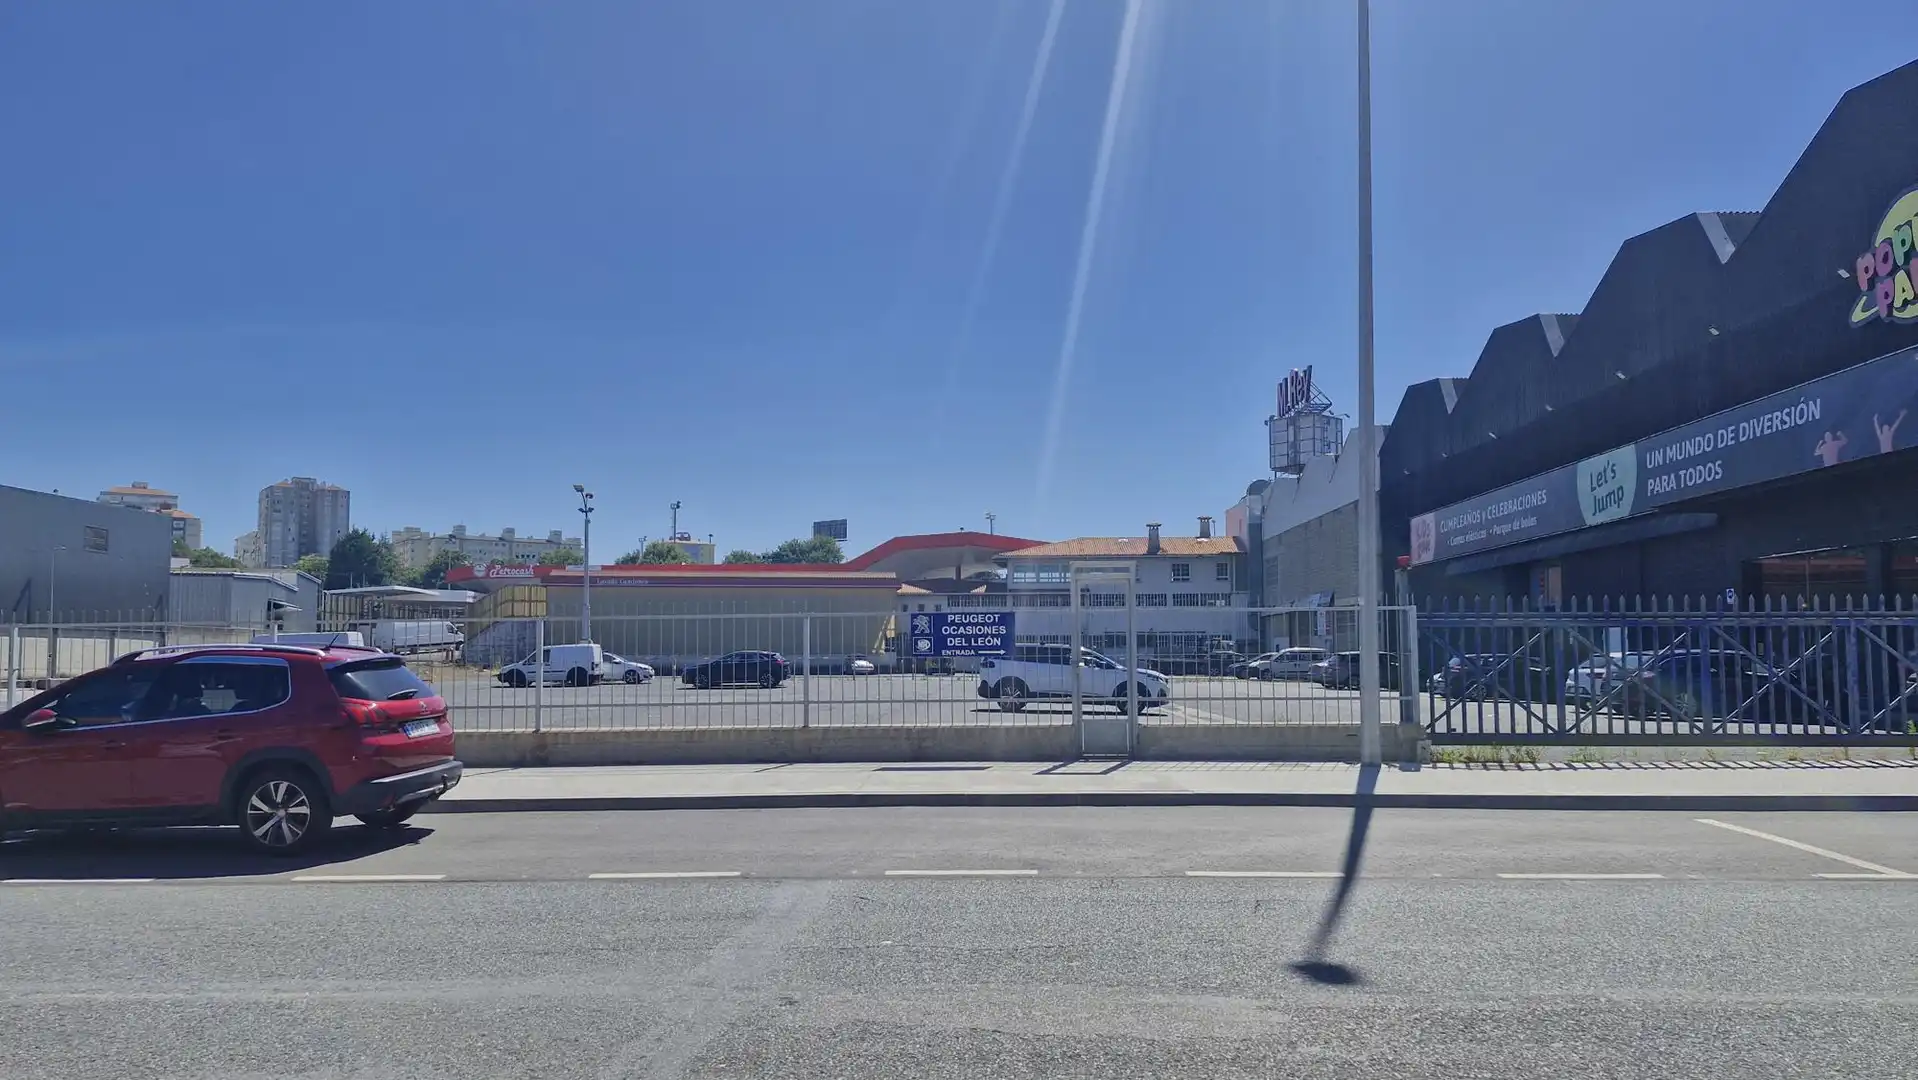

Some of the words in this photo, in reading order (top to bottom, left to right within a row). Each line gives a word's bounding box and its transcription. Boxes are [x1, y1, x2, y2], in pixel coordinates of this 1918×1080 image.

[1646, 448, 1663, 469] UN
[1666, 433, 1714, 463] MUNDO
[1717, 425, 1735, 449] DE
[1739, 397, 1821, 442] DIVERSIÓN
[1590, 460, 1617, 493] Let's
[1647, 473, 1677, 497] PARA
[1679, 460, 1723, 488] TODOS
[1440, 509, 1481, 533] CUMPLEAÑOS
[1481, 510, 1486, 526] y
[1487, 489, 1547, 520] CELEBRACIONES
[1592, 485, 1624, 516] Jump
[1512, 518, 1520, 530] de
[489, 564, 534, 578] Petrocash
[947, 614, 1001, 623] PEUGEOT
[941, 625, 1007, 635] OCASIONES
[947, 637, 968, 646] DEL
[972, 636, 1001, 646] LEÓN
